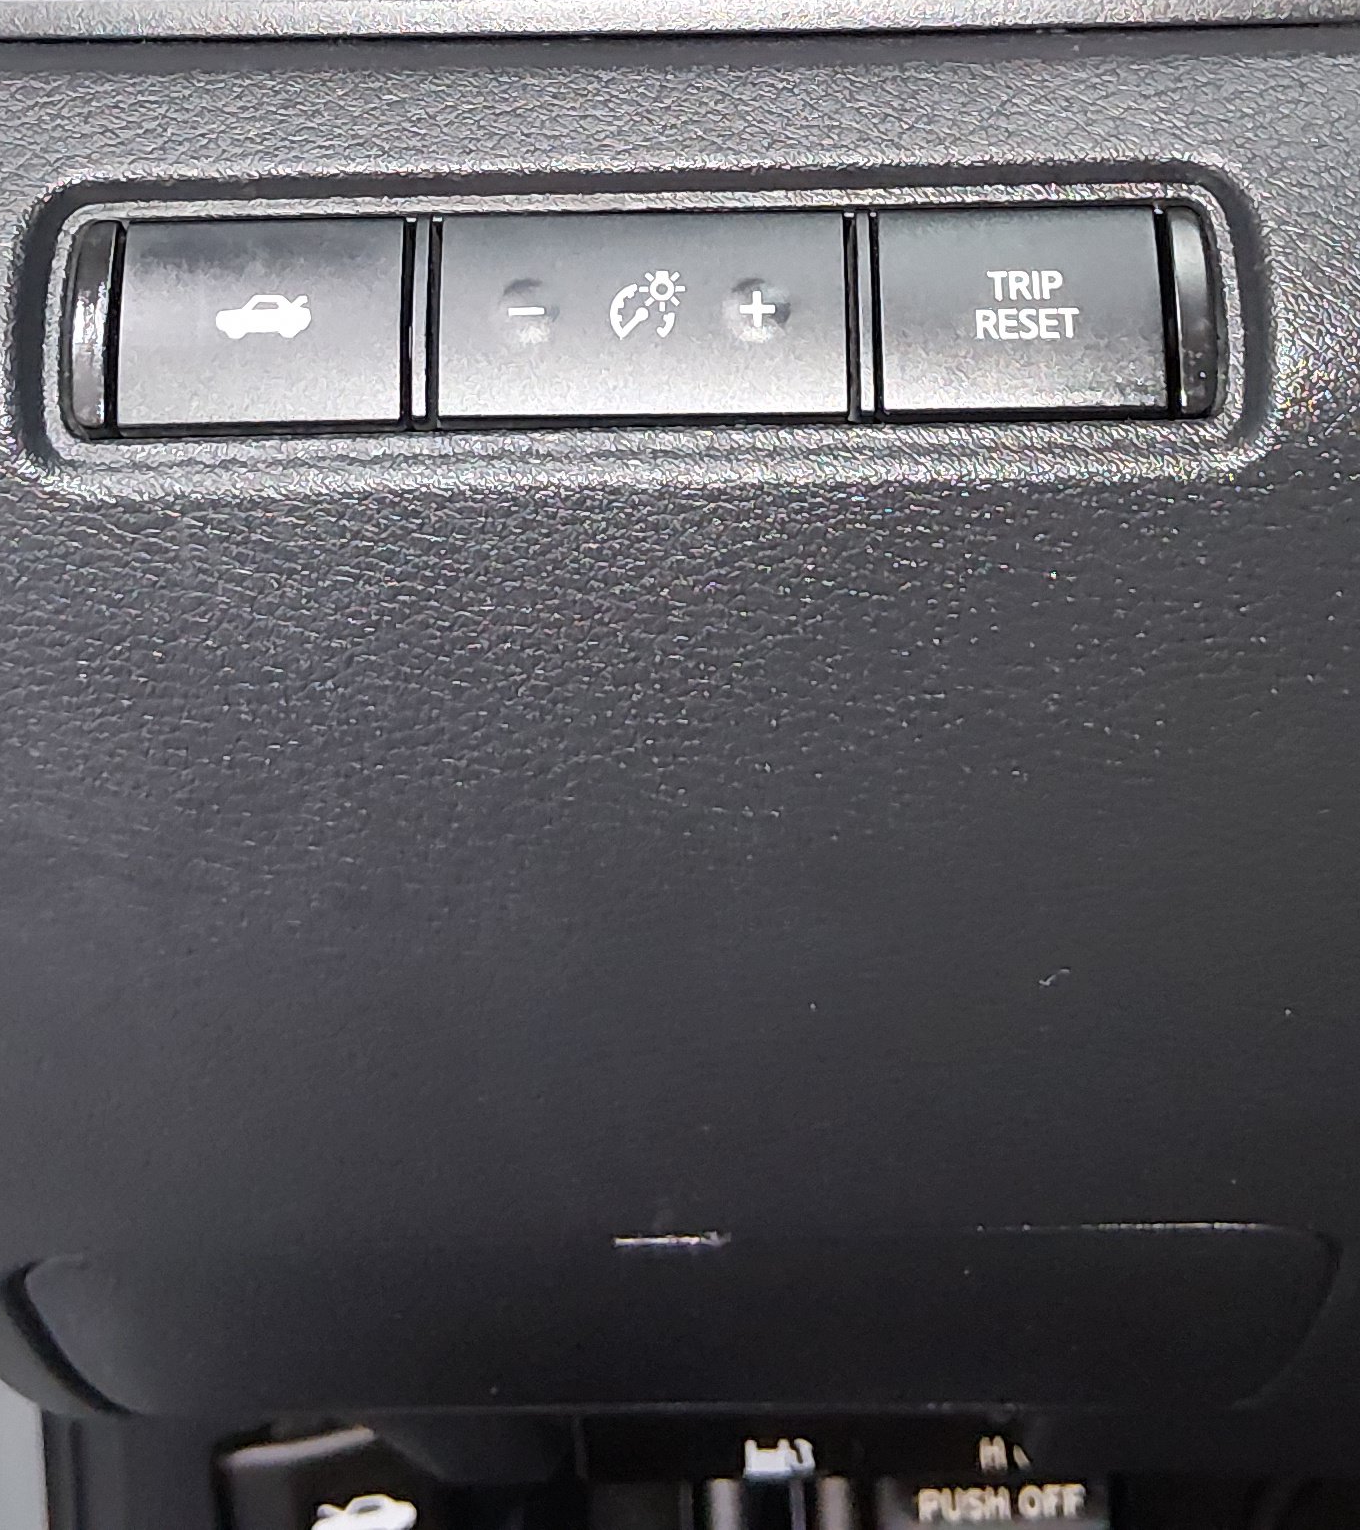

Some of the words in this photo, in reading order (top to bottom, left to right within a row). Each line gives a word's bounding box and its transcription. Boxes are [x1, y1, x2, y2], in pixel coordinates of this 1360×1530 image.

[986, 270, 1064, 302] TRIP
[975, 306, 1080, 340] RESET
[917, 1484, 1012, 1524] PUSH
[1016, 1482, 1086, 1522] OFF
